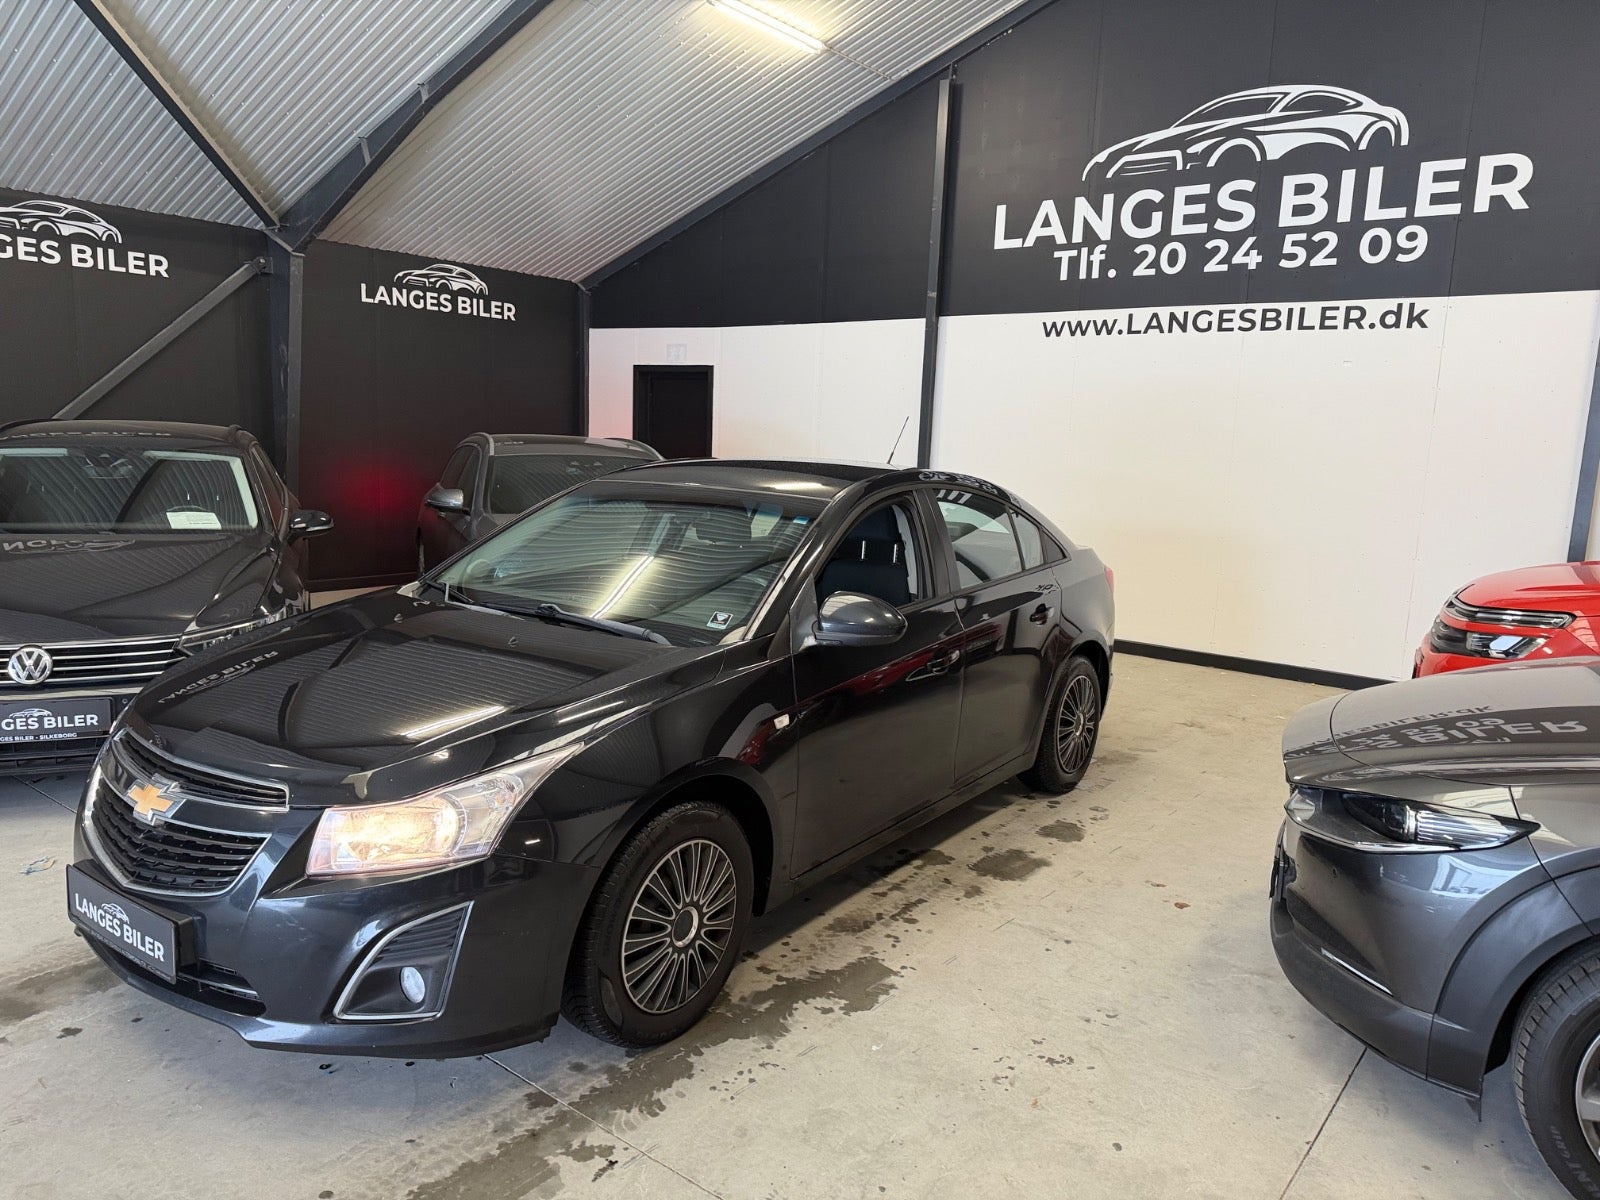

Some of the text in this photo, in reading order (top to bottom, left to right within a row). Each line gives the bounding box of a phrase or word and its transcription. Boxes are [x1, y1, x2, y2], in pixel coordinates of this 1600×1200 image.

[994, 153, 1534, 250] LANGES BILER
[71, 243, 169, 278] BILER
[1053, 225, 1429, 281] Tlf. 20 24 52 09
[361, 283, 516, 321] LANGES BILER
[1042, 302, 1430, 338] www.LANGESBILER.dk
[1, 714, 99, 731] GES BILER
[75, 893, 121, 937] LANGES
[123, 924, 164, 962] BILER
